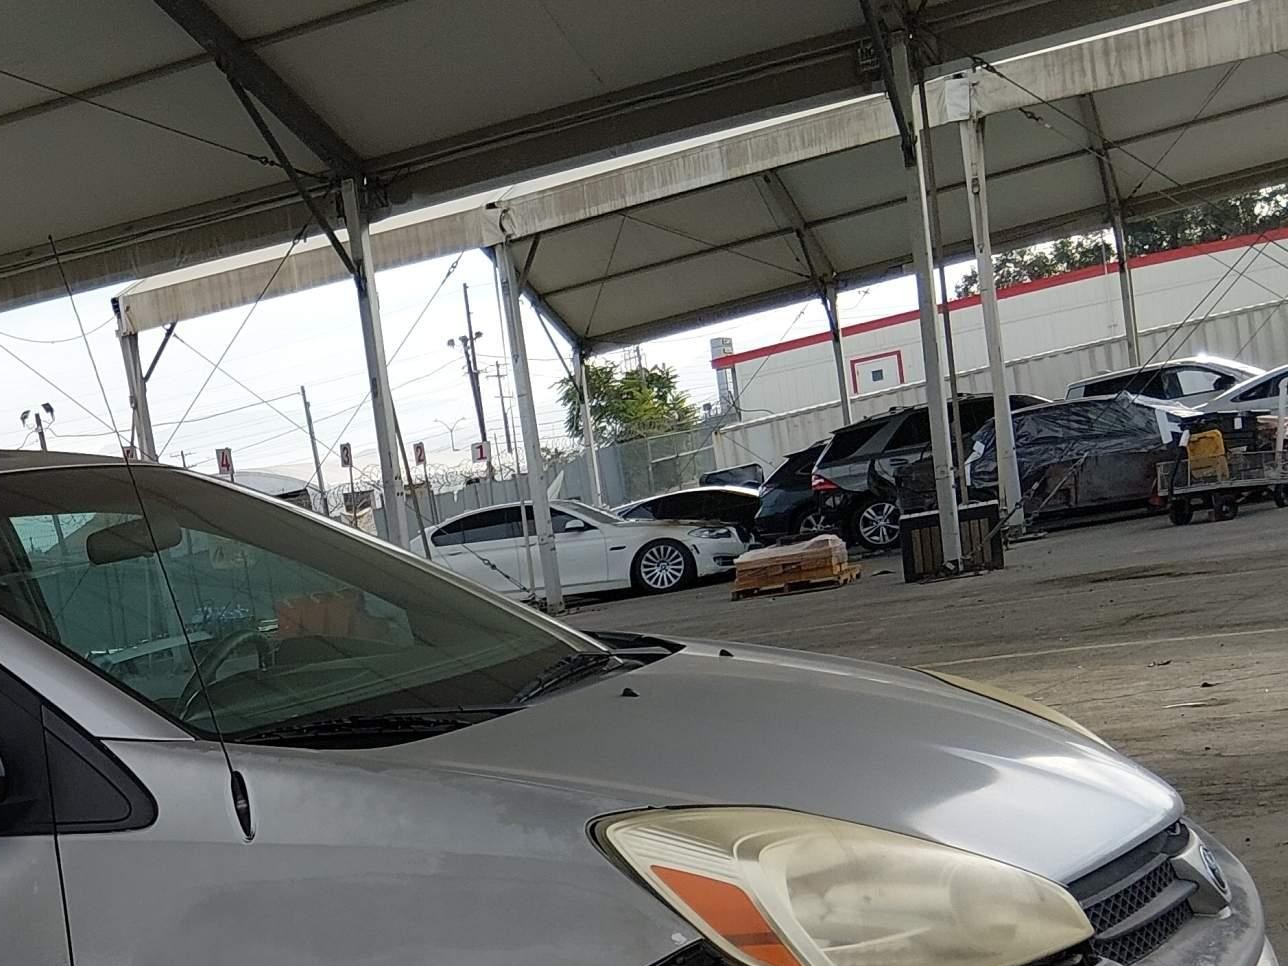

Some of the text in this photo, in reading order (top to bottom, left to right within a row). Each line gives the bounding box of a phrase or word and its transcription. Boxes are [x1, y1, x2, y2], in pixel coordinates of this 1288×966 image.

[221, 451, 231, 472] 4
[342, 446, 350, 466] 3
[415, 446, 425, 463] 2
[475, 444, 488, 461] 1
